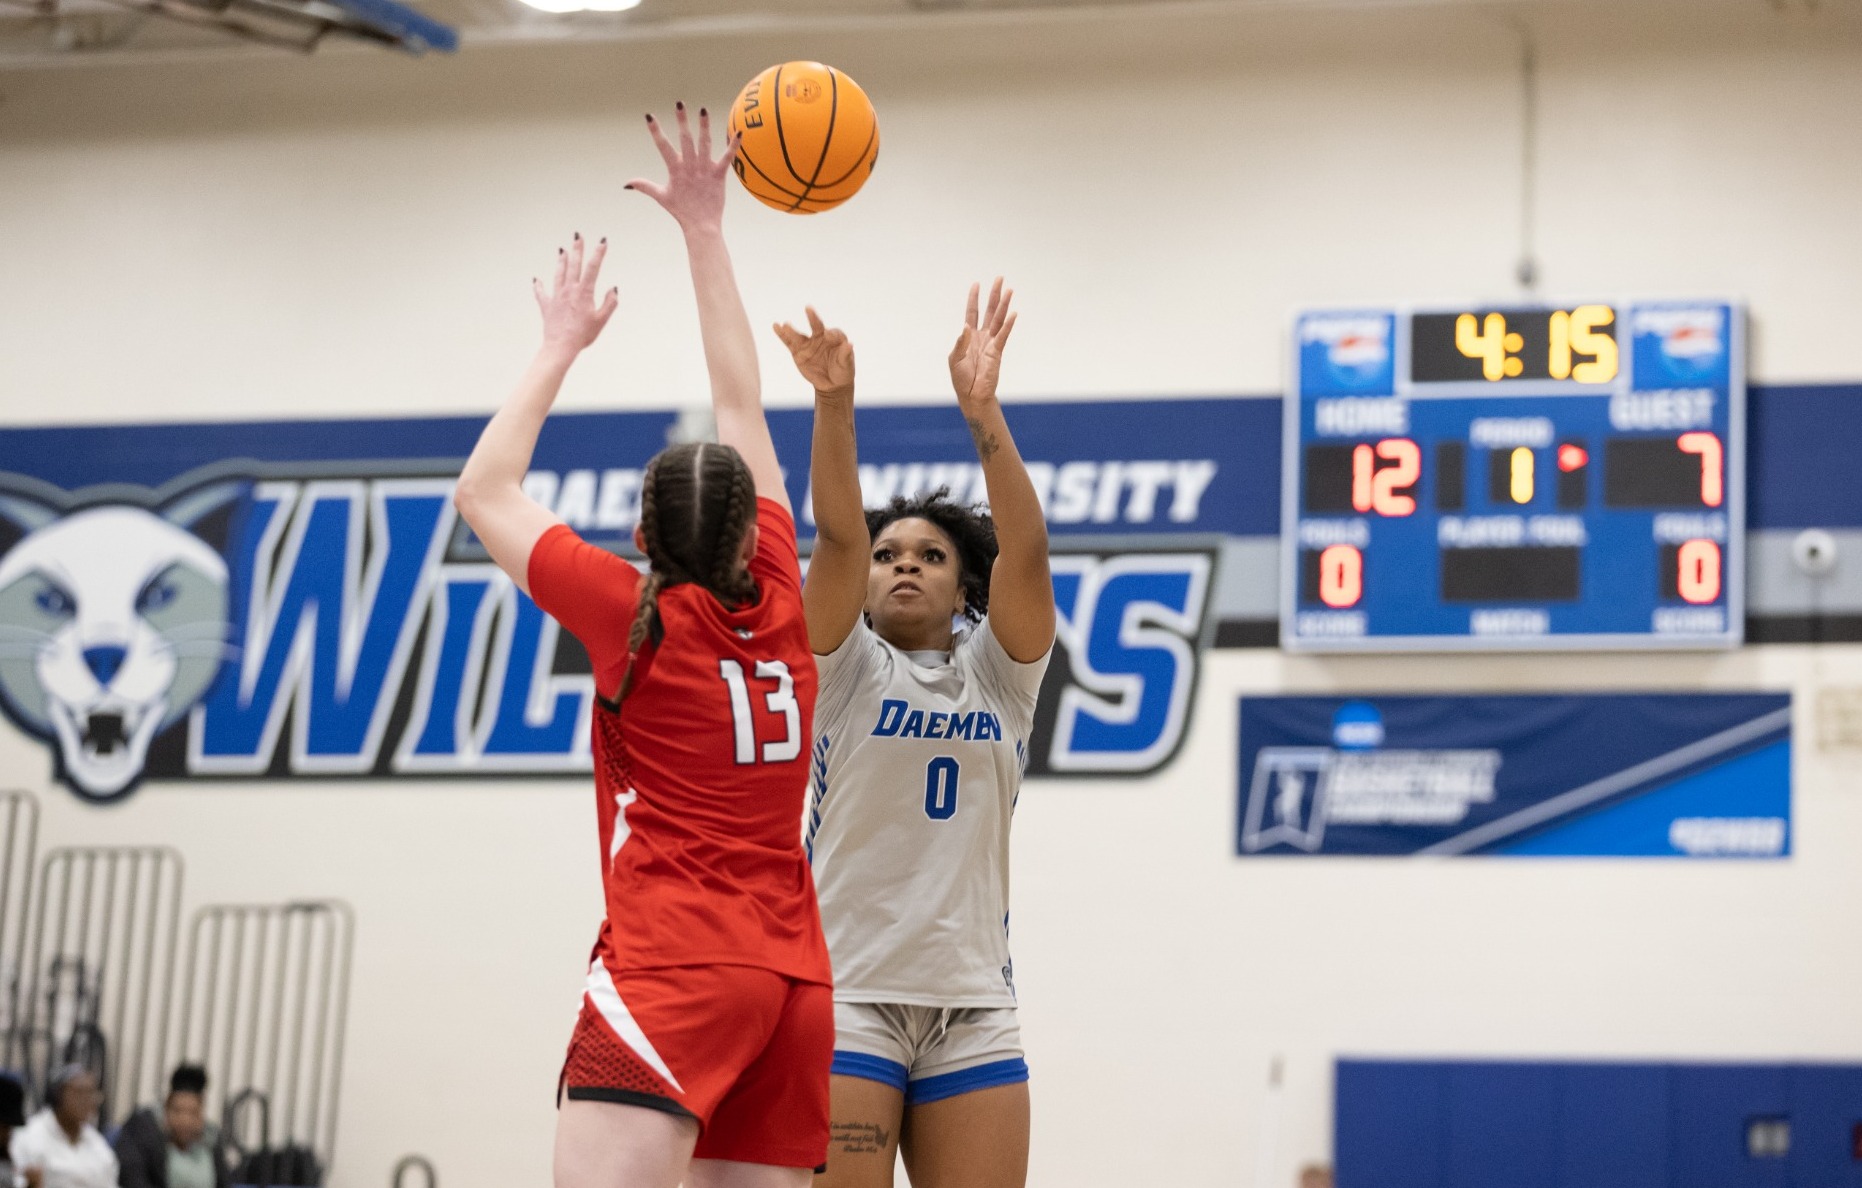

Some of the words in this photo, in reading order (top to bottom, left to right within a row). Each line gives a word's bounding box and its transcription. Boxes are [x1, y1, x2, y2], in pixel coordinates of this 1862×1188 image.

[1456, 304, 1619, 384] 4:15
[1316, 398, 1408, 436] HOME
[1610, 389, 1714, 431] GUEST
[1353, 438, 1421, 517] 12
[1510, 446, 1534, 504] 1
[1677, 432, 1723, 507] 7
[1319, 543, 1363, 608] 0
[1677, 538, 1721, 605] 0
[718, 658, 803, 766] 13
[924, 755, 961, 822] 0
